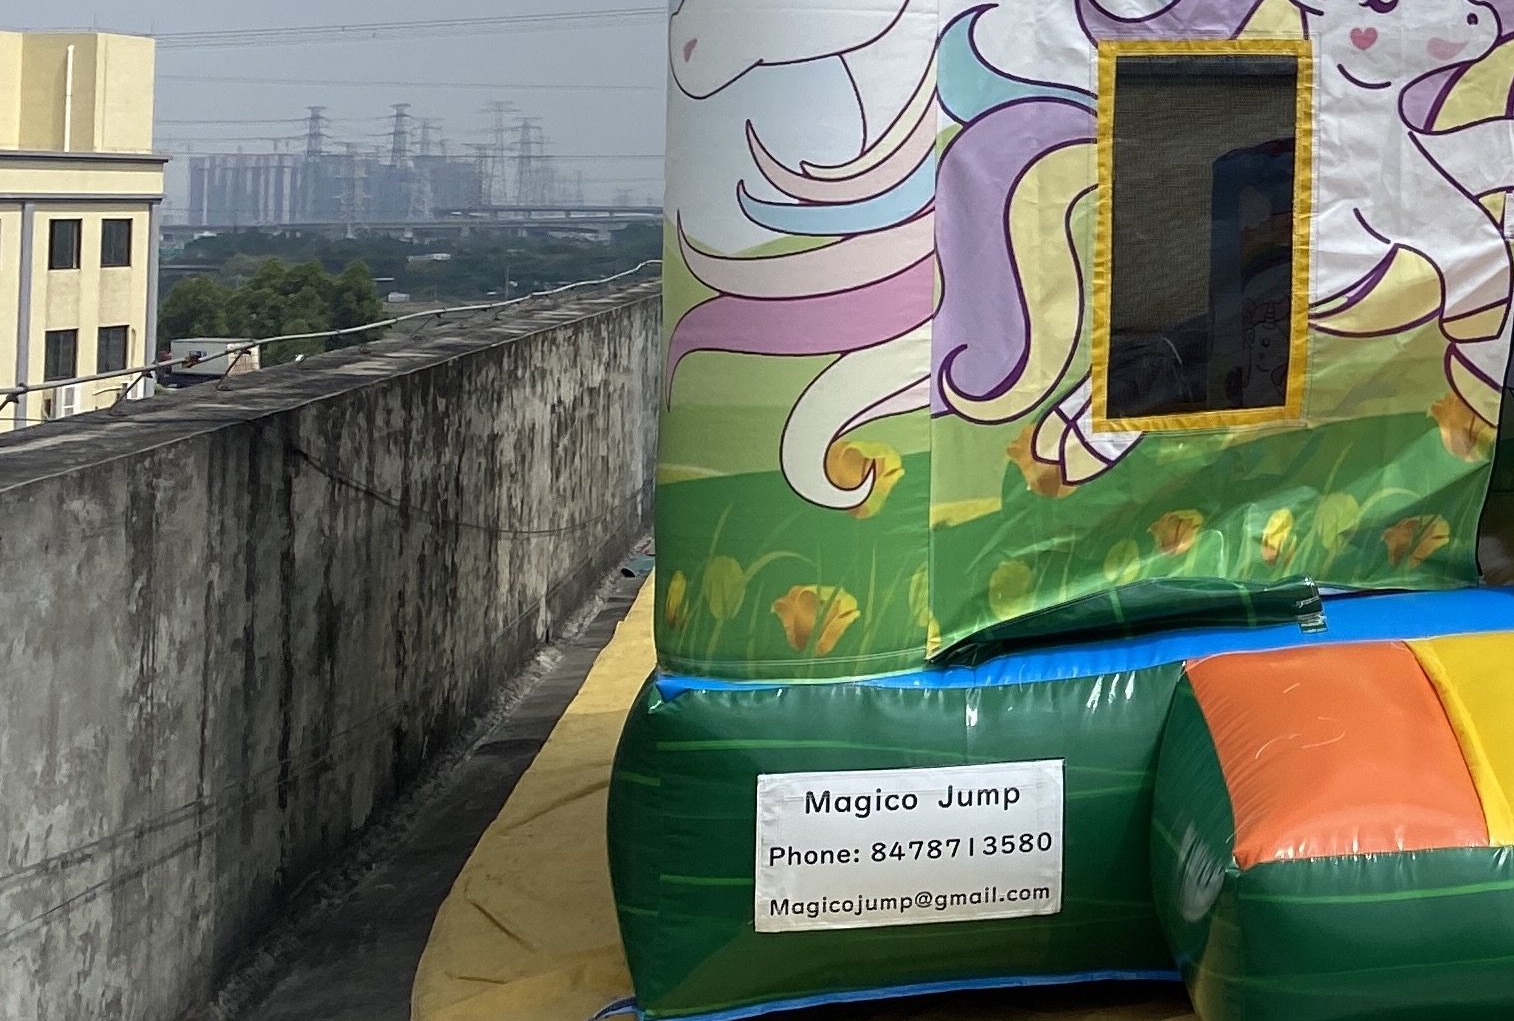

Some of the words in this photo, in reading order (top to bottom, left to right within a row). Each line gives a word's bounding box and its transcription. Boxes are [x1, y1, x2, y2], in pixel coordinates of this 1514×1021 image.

[805, 787, 918, 818] Magico
[938, 785, 1020, 811] Jump
[769, 845, 860, 867] Phone:
[871, 831, 1053, 862] 8478713580
[769, 885, 1051, 919] Magicojump@gmail.com
